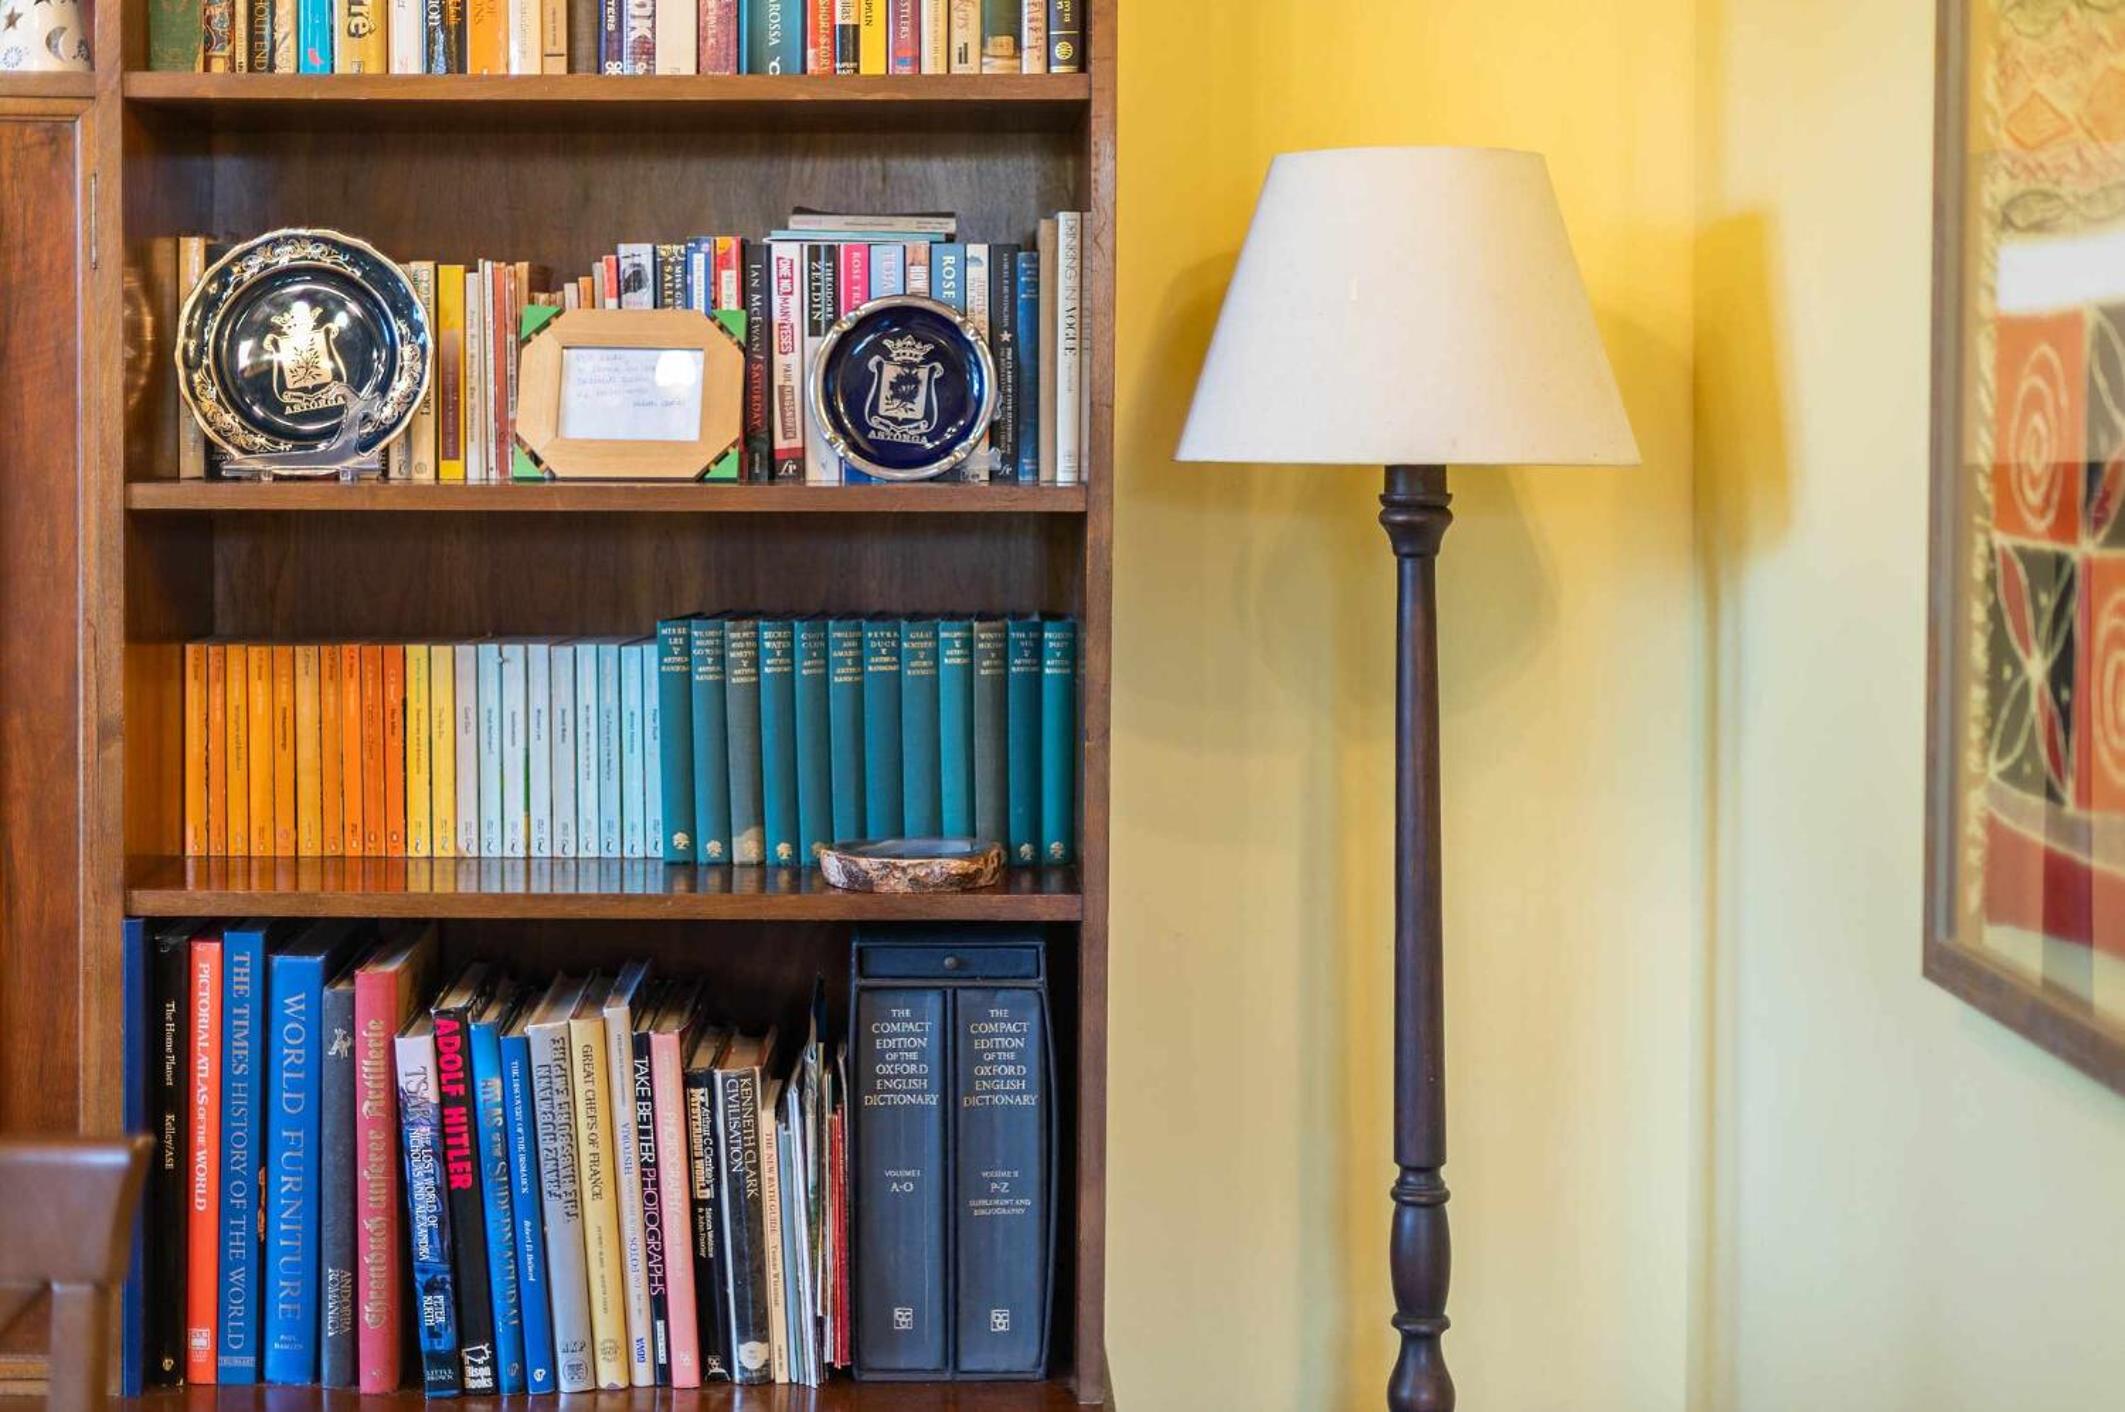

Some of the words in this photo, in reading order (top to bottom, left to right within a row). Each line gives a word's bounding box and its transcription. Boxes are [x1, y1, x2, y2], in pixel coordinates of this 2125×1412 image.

[255, 42, 268, 70] END
[1064, 218, 1078, 281] DRINKING
[751, 263, 762, 287] IAN
[779, 258, 793, 279] ONE
[942, 255, 956, 299] ROSE
[663, 265, 674, 309] SALLE
[811, 261, 823, 320] ZELDIN
[825, 260, 834, 320] THEODORE
[1065, 286, 1077, 300] IN
[779, 297, 790, 323] MANY
[780, 323, 793, 353] YESES
[1063, 305, 1078, 358] VOGUE
[782, 363, 792, 383] PAUL
[751, 363, 763, 427] SATURDAY
[782, 385, 796, 439] KINGSNORTH
[867, 431, 930, 444] ASTORGA
[231, 951, 251, 998] THE
[165, 1000, 176, 1021] The
[196, 962, 211, 1053] PICTORIAL
[891, 1009, 912, 1019] THE
[988, 1009, 1009, 1019] THE
[165, 1022, 176, 1053] Home
[231, 1003, 250, 1075] TIMES
[871, 1022, 932, 1034] COMPACT
[875, 1037, 929, 1049] EDITION
[969, 1022, 1031, 1035] COMPACT
[973, 1037, 1026, 1049] EDITION
[281, 992, 306, 1114] WORLD
[434, 1018, 466, 1098] ADOLF
[511, 1060, 520, 1076] THE
[551, 1036, 569, 1097] EMPIRE
[582, 1044, 594, 1085] GREAT
[875, 1063, 929, 1075] OXFORD
[885, 1052, 899, 1061] OF
[900, 1052, 919, 1061] THE
[982, 1052, 996, 1061] OF
[996, 1052, 1016, 1061] THE
[165, 1055, 176, 1086] Planet
[196, 1053, 209, 1105] ATLAS
[634, 1056, 651, 1097] TAKE
[876, 1078, 928, 1090] ENGLISH
[973, 1064, 1027, 1076] OXFORD
[974, 1079, 1026, 1091] ENGLISH
[404, 1066, 433, 1123] TSAR
[480, 1077, 504, 1126] ATLAS
[512, 1077, 523, 1122] DISCOVERY
[535, 1064, 557, 1144] HUBMANN
[585, 1089, 597, 1130] CHEFS
[863, 1094, 940, 1106] DICTIONARY
[962, 1095, 1039, 1107] DICTIONARY
[197, 1106, 207, 1123] OF
[690, 1088, 706, 1159] MYSTERIOUS
[701, 1107, 713, 1136] Arthur
[725, 1078, 743, 1173] CIVILISATION
[739, 1077, 755, 1147] KENNETH
[197, 1124, 207, 1145] THE
[229, 1082, 248, 1177] HISTORY
[420, 1127, 434, 1147] THE
[515, 1123, 524, 1135] OF
[517, 1136, 525, 1151] THE
[556, 1101, 576, 1186] HABSBURG
[588, 1132, 599, 1149] OF
[636, 1101, 655, 1163] BETTER
[703, 1137, 713, 1145] C
[765, 1132, 774, 1146] THE
[409, 1128, 423, 1177] NICHOLAS
[421, 1149, 434, 1176] LOST
[443, 1106, 473, 1190] HITLER
[621, 1122, 634, 1177] HISTORIA
[765, 1147, 775, 1174] NEW
[194, 1150, 208, 1211] WORLD
[518, 1153, 529, 1194] BISMARCK
[542, 1148, 562, 1201] FRANZ
[589, 1152, 603, 1201] FRANCE
[694, 1159, 711, 1199] WORLD
[703, 1146, 715, 1185] Clarke's
[743, 1149, 759, 1200] CLARK
[884, 1169, 915, 1178] VOLUME
[228, 1180, 247, 1209] OF
[412, 1181, 425, 1200] AND
[423, 1178, 438, 1213] WORLD
[890, 1182, 914, 1193] A-O
[990, 1182, 1010, 1193] P-Z
[561, 1189, 578, 1222] THE
[228, 1215, 246, 1261] THE
[277, 1128, 304, 1320] FURNITURE
[414, 1204, 429, 1261] ALEXANDRA
[427, 1217, 439, 1228] OF
[642, 1168, 665, 1296] PHOTOGRAPHS
[226, 1266, 246, 1350] WORLD
[327, 1266, 340, 1338] ROMANICA
[340, 1269, 353, 1334] ANDORRA
[423, 1295, 435, 1327] KURTH
[433, 1295, 446, 1324] PETER
[636, 1337, 647, 1363] BBVA
